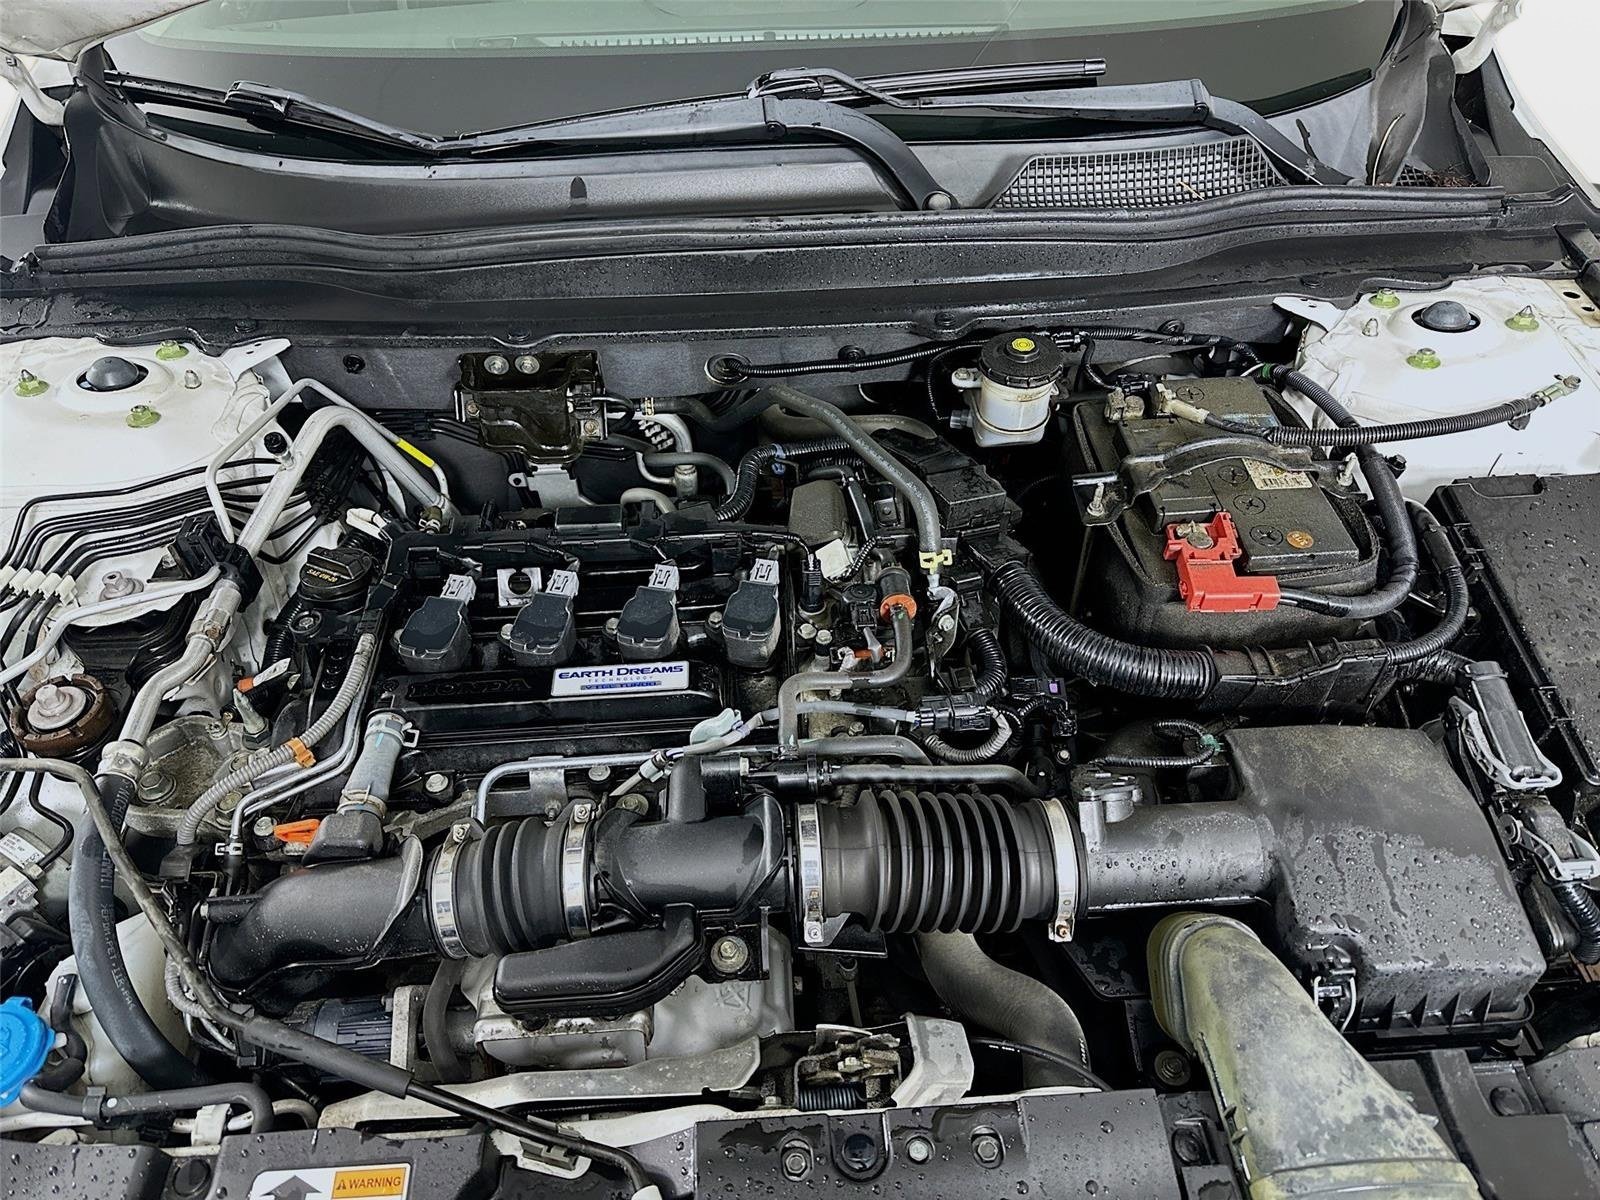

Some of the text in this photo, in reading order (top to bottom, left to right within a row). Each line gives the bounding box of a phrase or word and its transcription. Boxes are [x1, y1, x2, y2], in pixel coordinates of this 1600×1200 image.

[558, 665, 684, 680] EARTH DREAMS
[350, 1177, 401, 1189] WARNING
